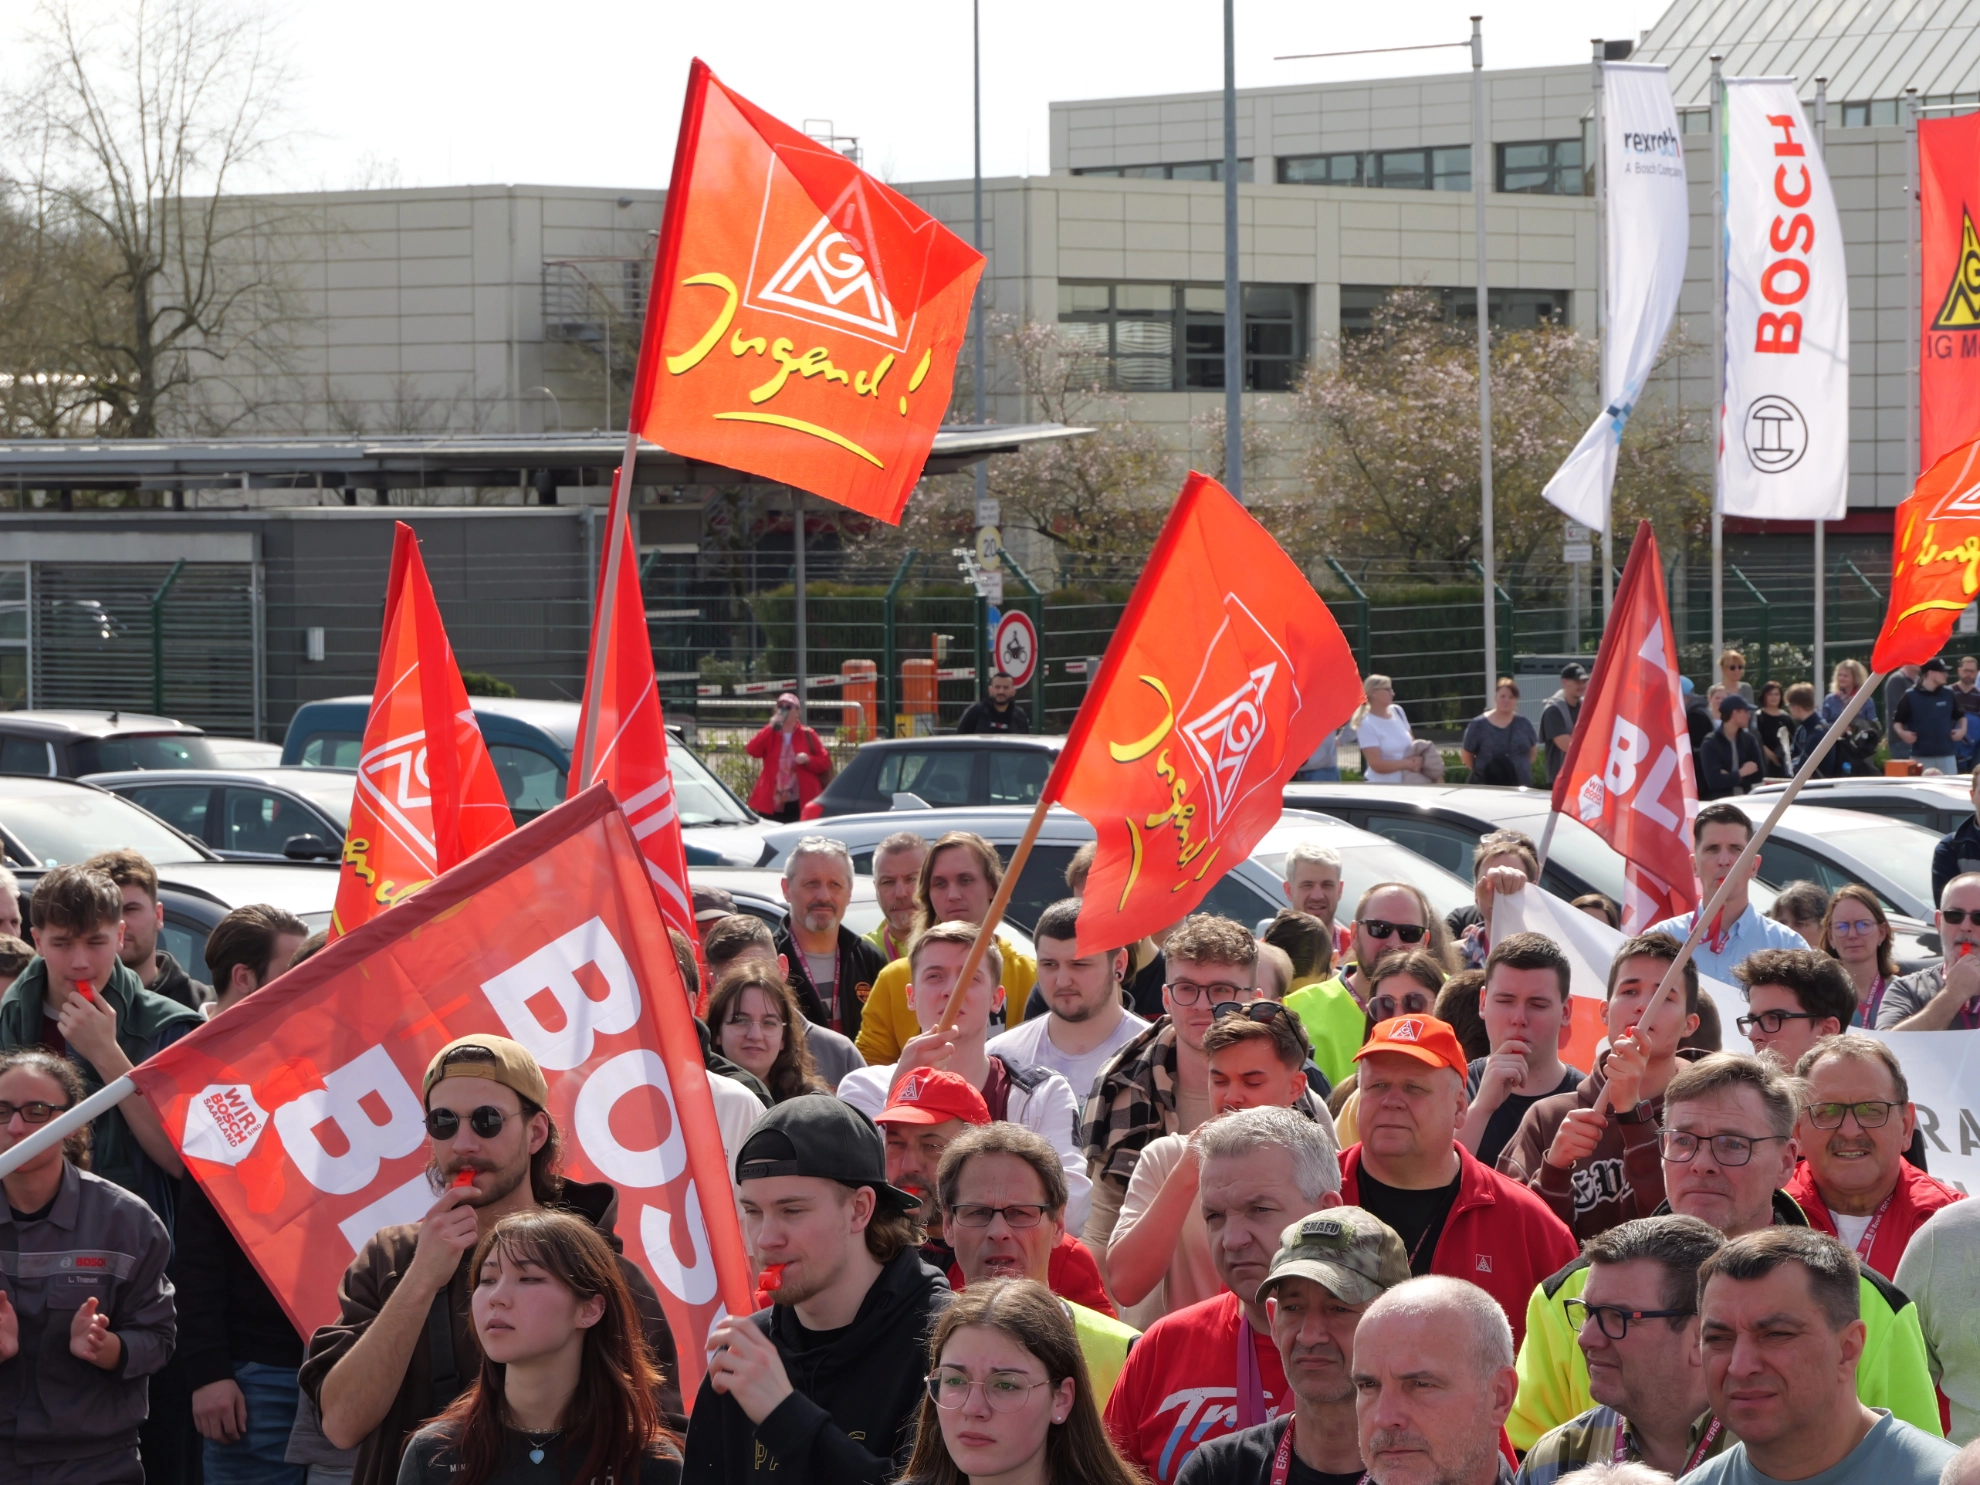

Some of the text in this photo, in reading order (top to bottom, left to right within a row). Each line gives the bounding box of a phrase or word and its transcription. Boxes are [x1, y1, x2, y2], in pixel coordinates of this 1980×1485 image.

[1755, 113, 1815, 354] BOSCH
[1927, 334, 1953, 359] IG
[983, 538, 998, 558] 20
[203, 1098, 238, 1148] SAARLAND
[210, 1092, 248, 1145] BOSCH
[223, 1086, 257, 1131] WIR
[247, 1123, 262, 1137] SIND
[480, 915, 734, 1362] BOS
[75, 1257, 107, 1267] BOSCH
[1275, 1429, 1292, 1470] ERSTER
[1706, 1416, 1721, 1443] ERS
